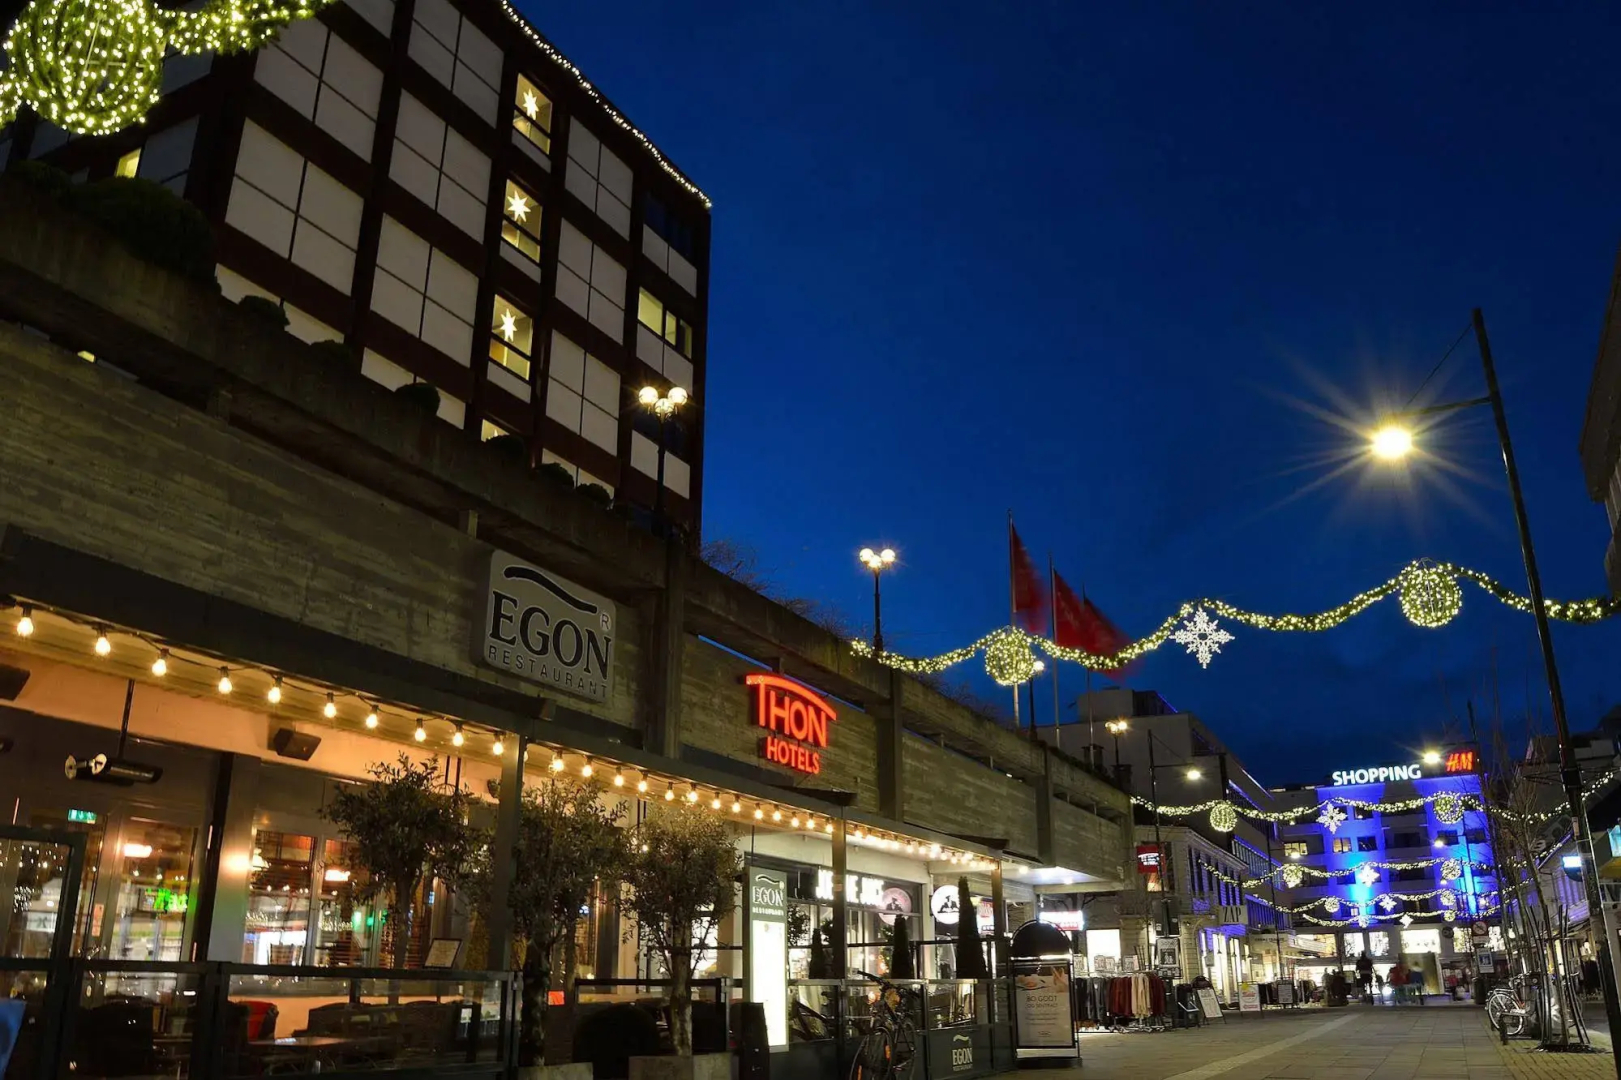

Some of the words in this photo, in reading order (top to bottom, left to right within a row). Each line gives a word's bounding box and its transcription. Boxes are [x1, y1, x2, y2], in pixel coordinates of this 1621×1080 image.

[489, 591, 612, 680] EGON
[488, 645, 607, 698] RESTAURANT
[745, 674, 837, 747] THON
[766, 736, 820, 774] HOTELS
[1446, 751, 1474, 772] H&M
[1332, 764, 1422, 786] SHOPPING
[752, 886, 784, 907] EGON
[1223, 906, 1242, 923] ZAP
[952, 1047, 973, 1065] EGON
